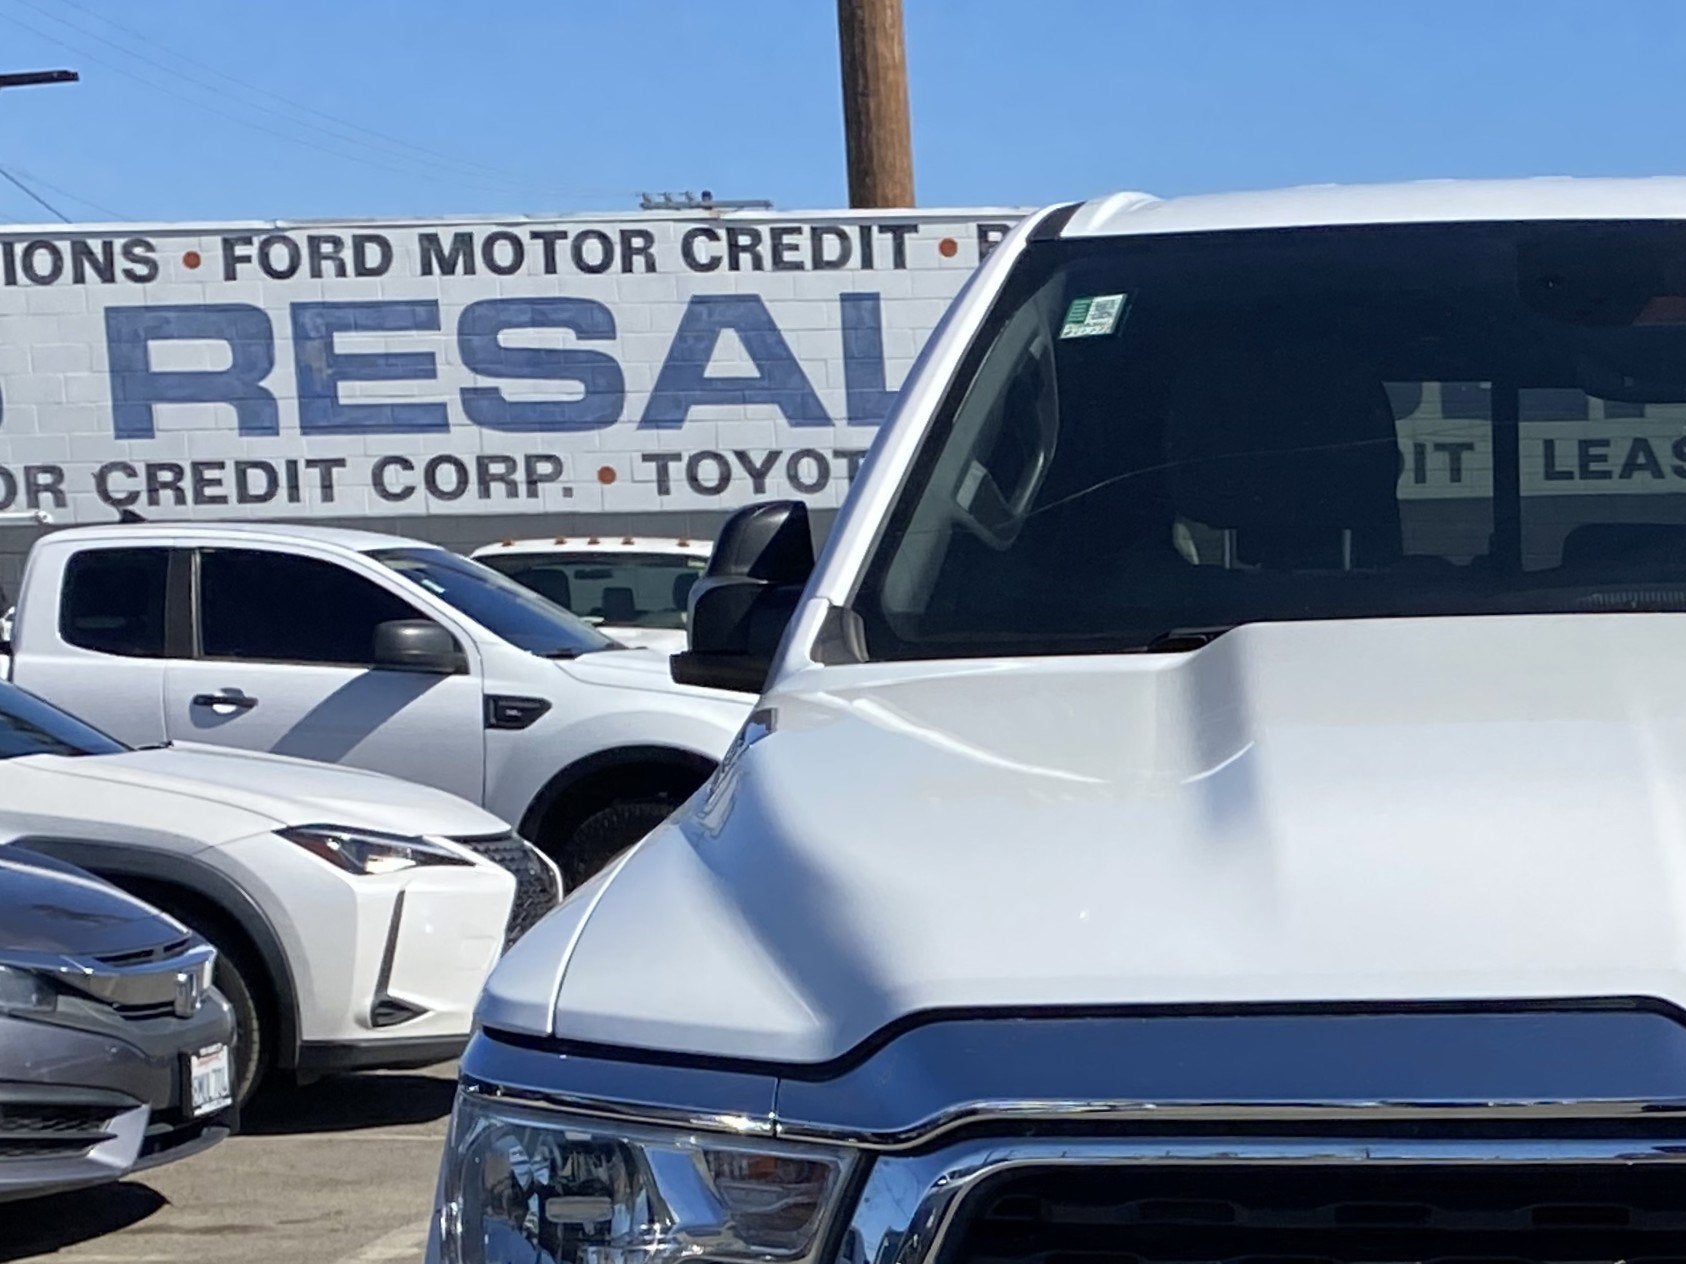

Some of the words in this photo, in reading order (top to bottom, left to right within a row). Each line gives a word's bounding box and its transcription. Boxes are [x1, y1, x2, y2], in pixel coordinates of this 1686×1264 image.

[2, 237, 160, 286] IONS
[221, 232, 394, 281] FORD
[418, 229, 657, 277] MOTOR
[681, 224, 918, 273] CREDIT
[104, 292, 902, 440] RESAL
[95, 458, 347, 507] CREDIT
[372, 453, 574, 502] CORP.
[641, 448, 868, 497] TOYOT
[1399, 441, 1475, 485] IT
